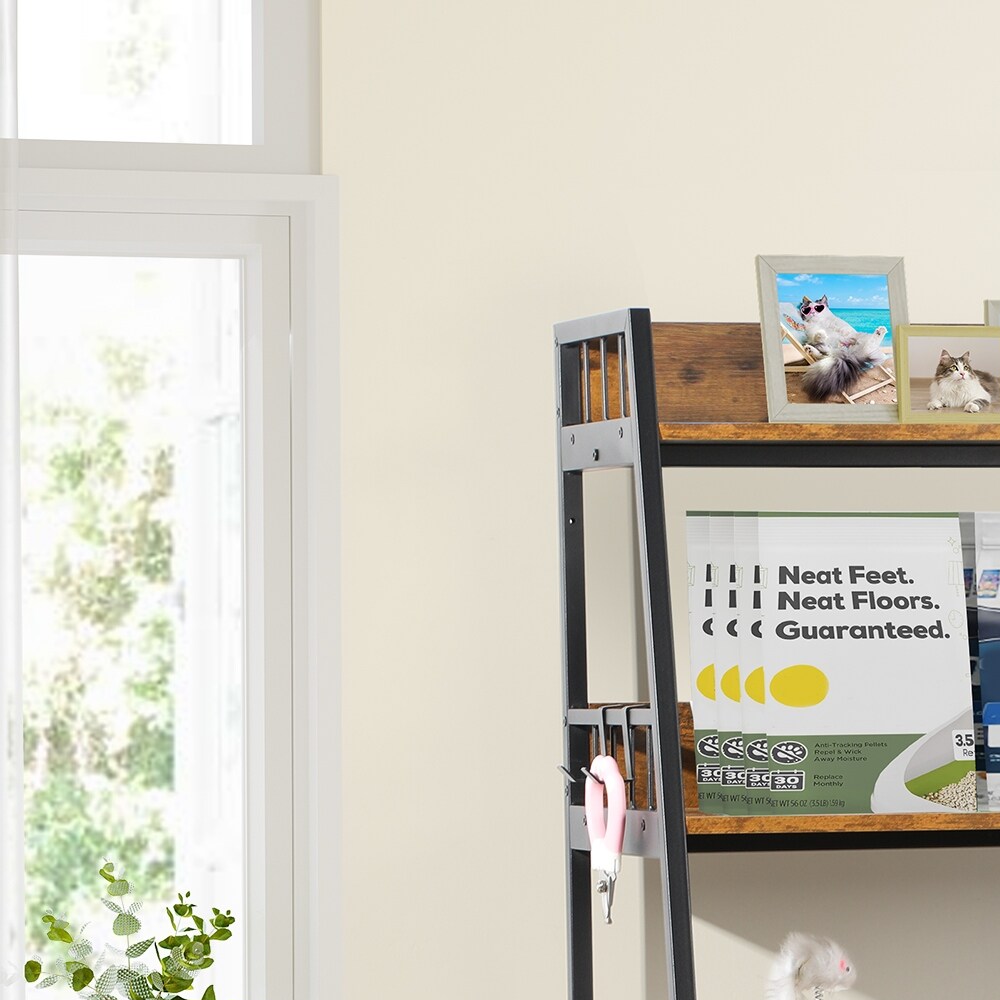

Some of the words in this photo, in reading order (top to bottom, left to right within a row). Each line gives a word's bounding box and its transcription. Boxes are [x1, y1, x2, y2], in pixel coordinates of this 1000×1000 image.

[778, 565, 843, 585] Neat
[848, 565, 915, 585] Feet.
[777, 591, 846, 611] Neat
[851, 590, 941, 610] Floors.
[775, 620, 951, 641] Guaranteed.
[955, 733, 975, 747] 3.5
[774, 776, 799, 785] 30
[780, 799, 790, 807] WT
[790, 799, 799, 807] 56
